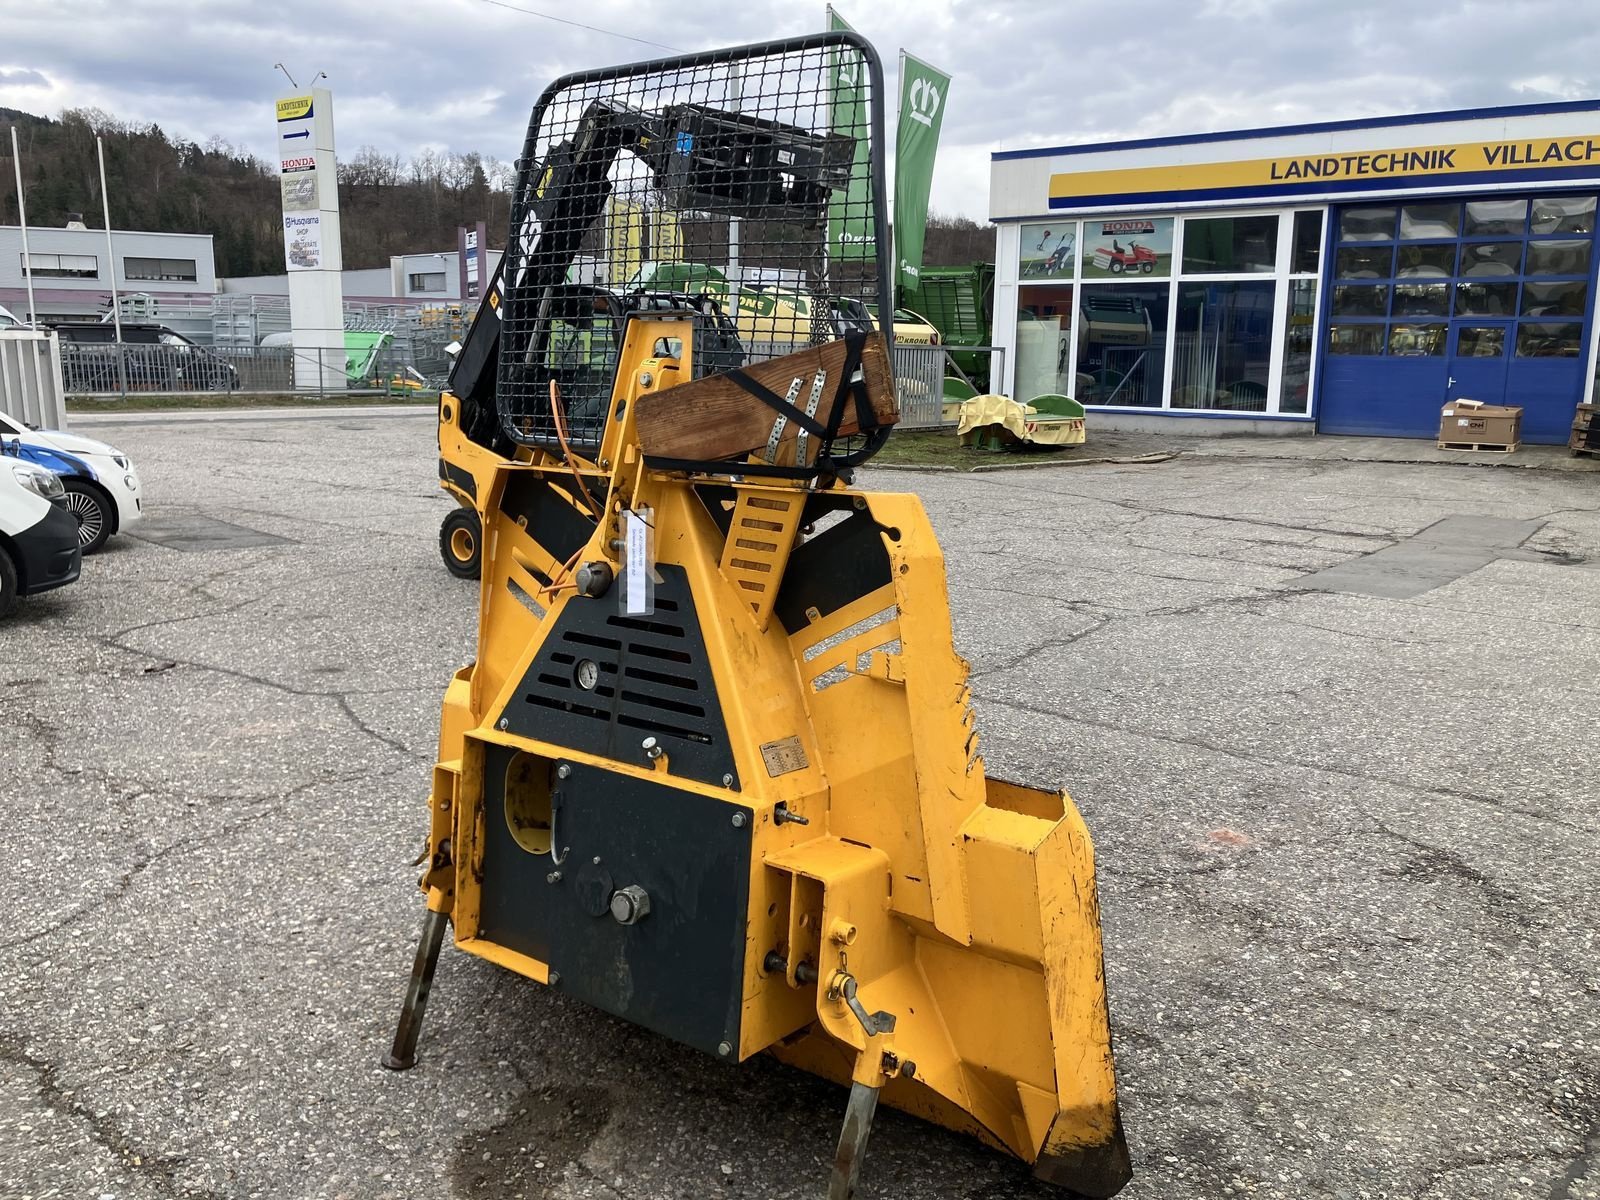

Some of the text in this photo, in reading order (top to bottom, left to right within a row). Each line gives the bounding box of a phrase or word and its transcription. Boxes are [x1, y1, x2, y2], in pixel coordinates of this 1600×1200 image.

[278, 100, 309, 112] LANDTECHNIK
[282, 158, 315, 168] HONDA
[1270, 140, 1600, 181] LANDTECHNIK VILLACH
[290, 217, 319, 226] Husqvarna
[1103, 221, 1154, 230] HONDA
[296, 228, 309, 236] SHOP
[904, 337, 929, 345] KRONE
